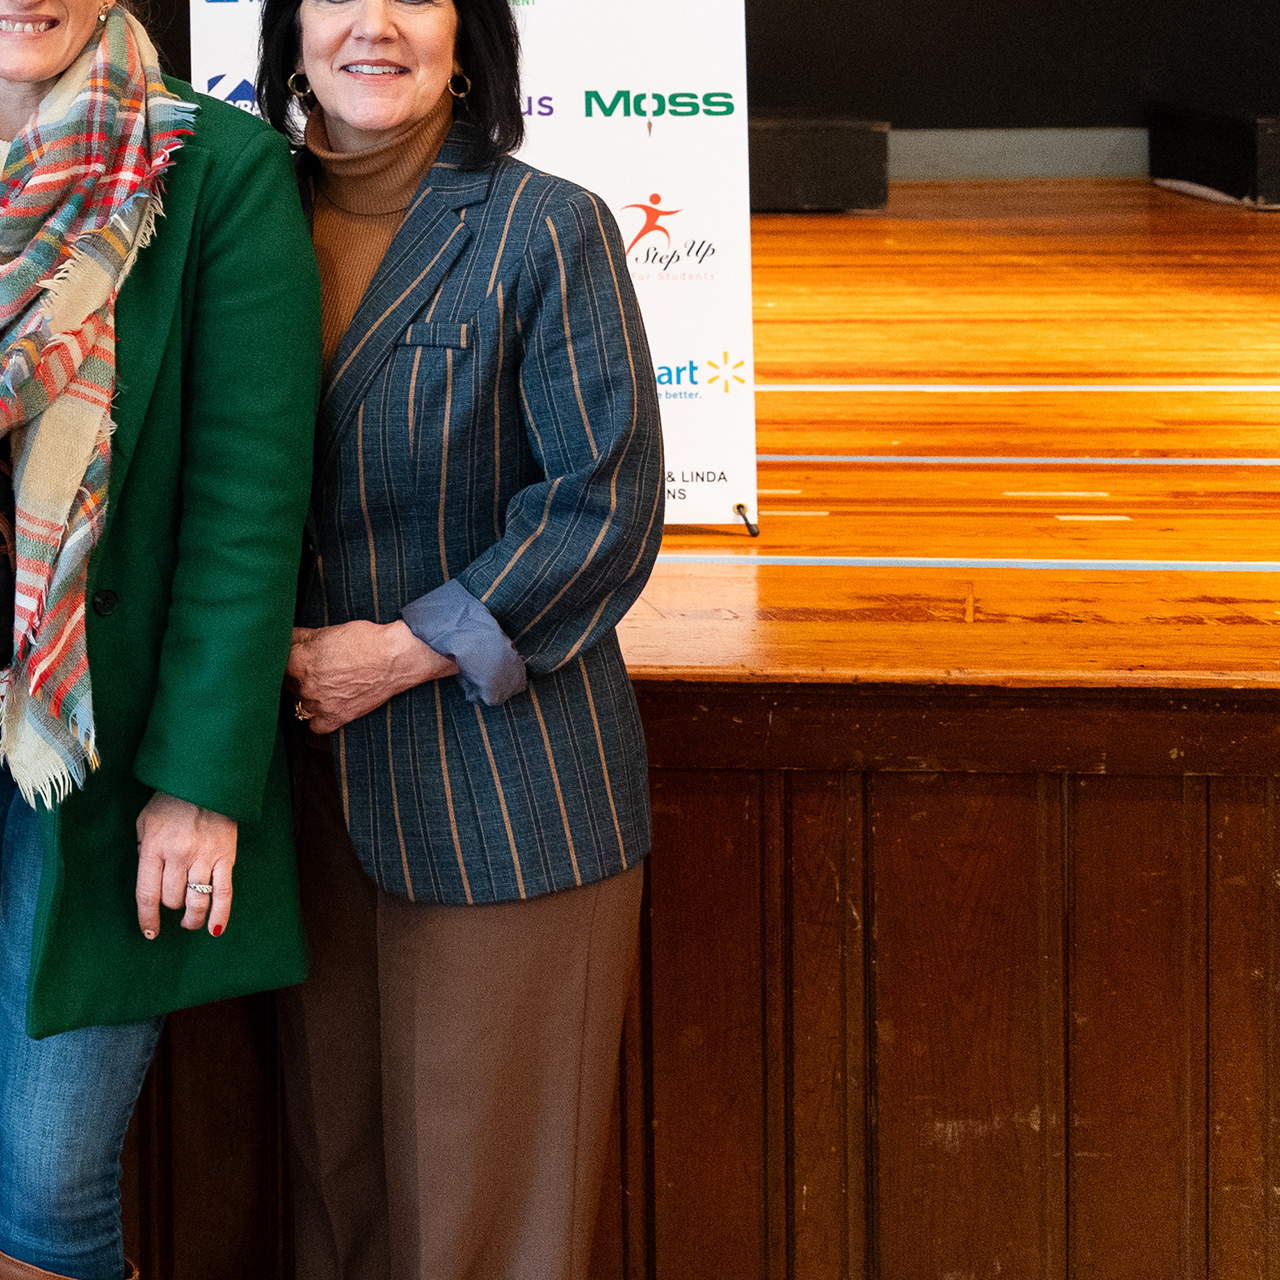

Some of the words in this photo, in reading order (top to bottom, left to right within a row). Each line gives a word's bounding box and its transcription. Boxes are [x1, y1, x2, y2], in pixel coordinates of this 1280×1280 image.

[635, 245, 680, 271] Step
[684, 239, 716, 264] Up
[681, 471, 728, 483] LINDA
